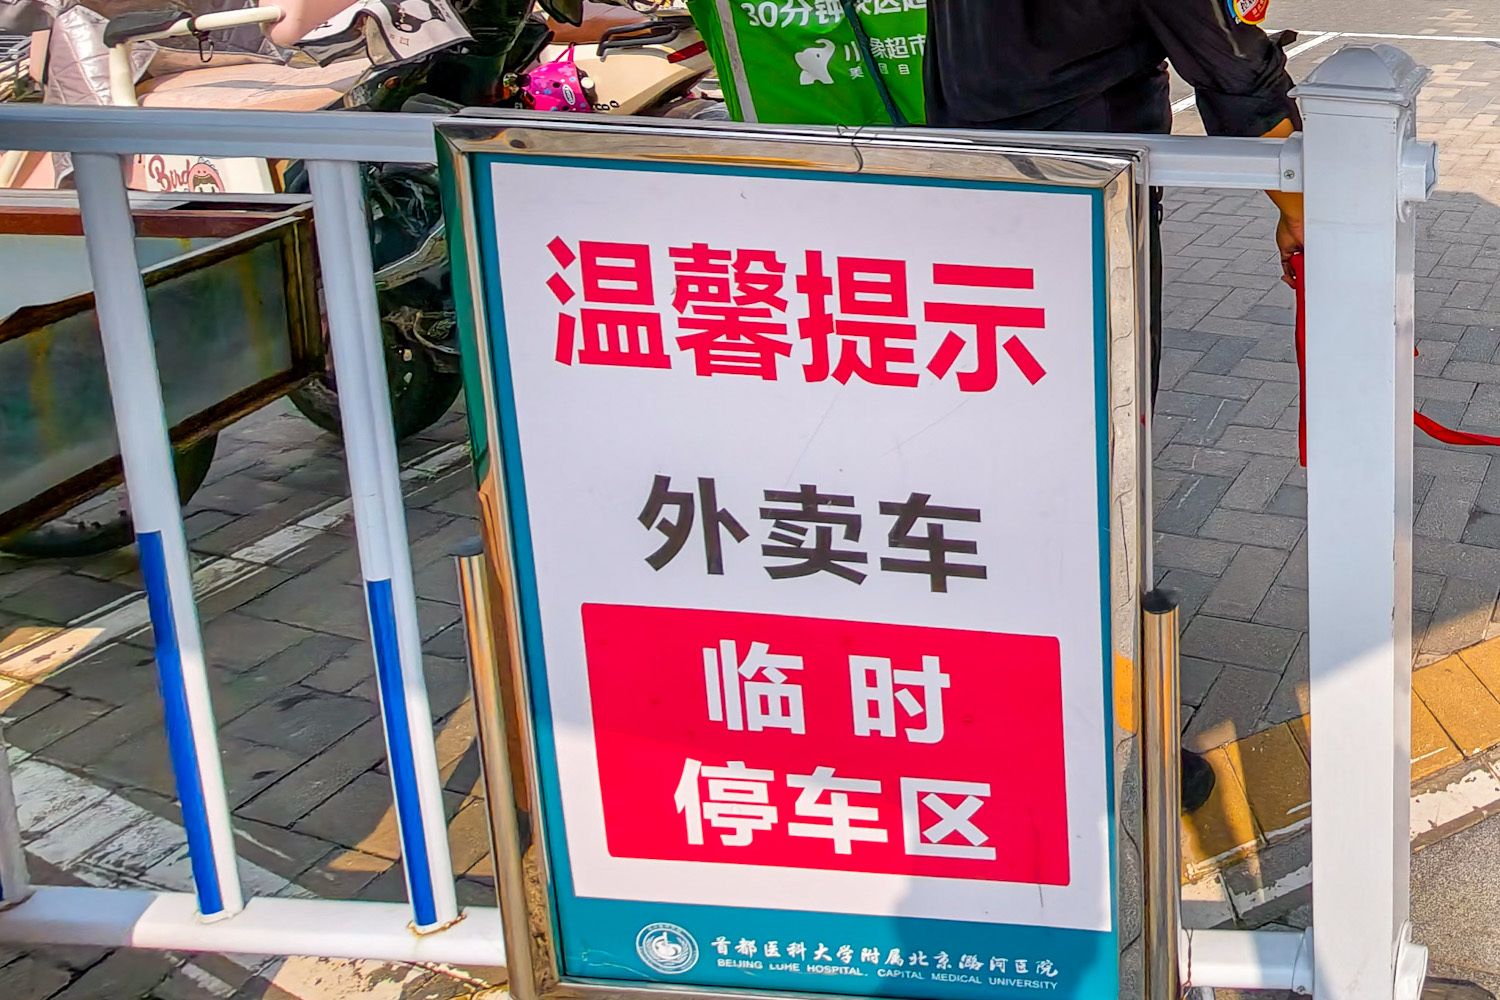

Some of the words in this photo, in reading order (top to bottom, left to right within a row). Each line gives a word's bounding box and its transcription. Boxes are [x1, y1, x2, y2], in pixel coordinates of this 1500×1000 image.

[546, 235, 1047, 392] 温馨提示
[637, 475, 988, 593] 外卖车
[702, 639, 951, 744] 临时
[674, 758, 996, 860] 停车区
[711, 936, 1059, 977] 首都医科大学附属北京潞河医院
[717, 958, 763, 970] BEIJING
[769, 963, 800, 972] LUHE
[877, 968, 925, 980] CAPITAL
[931, 972, 983, 985] MEDICAL
[988, 977, 1058, 990] UNIVERSITY
